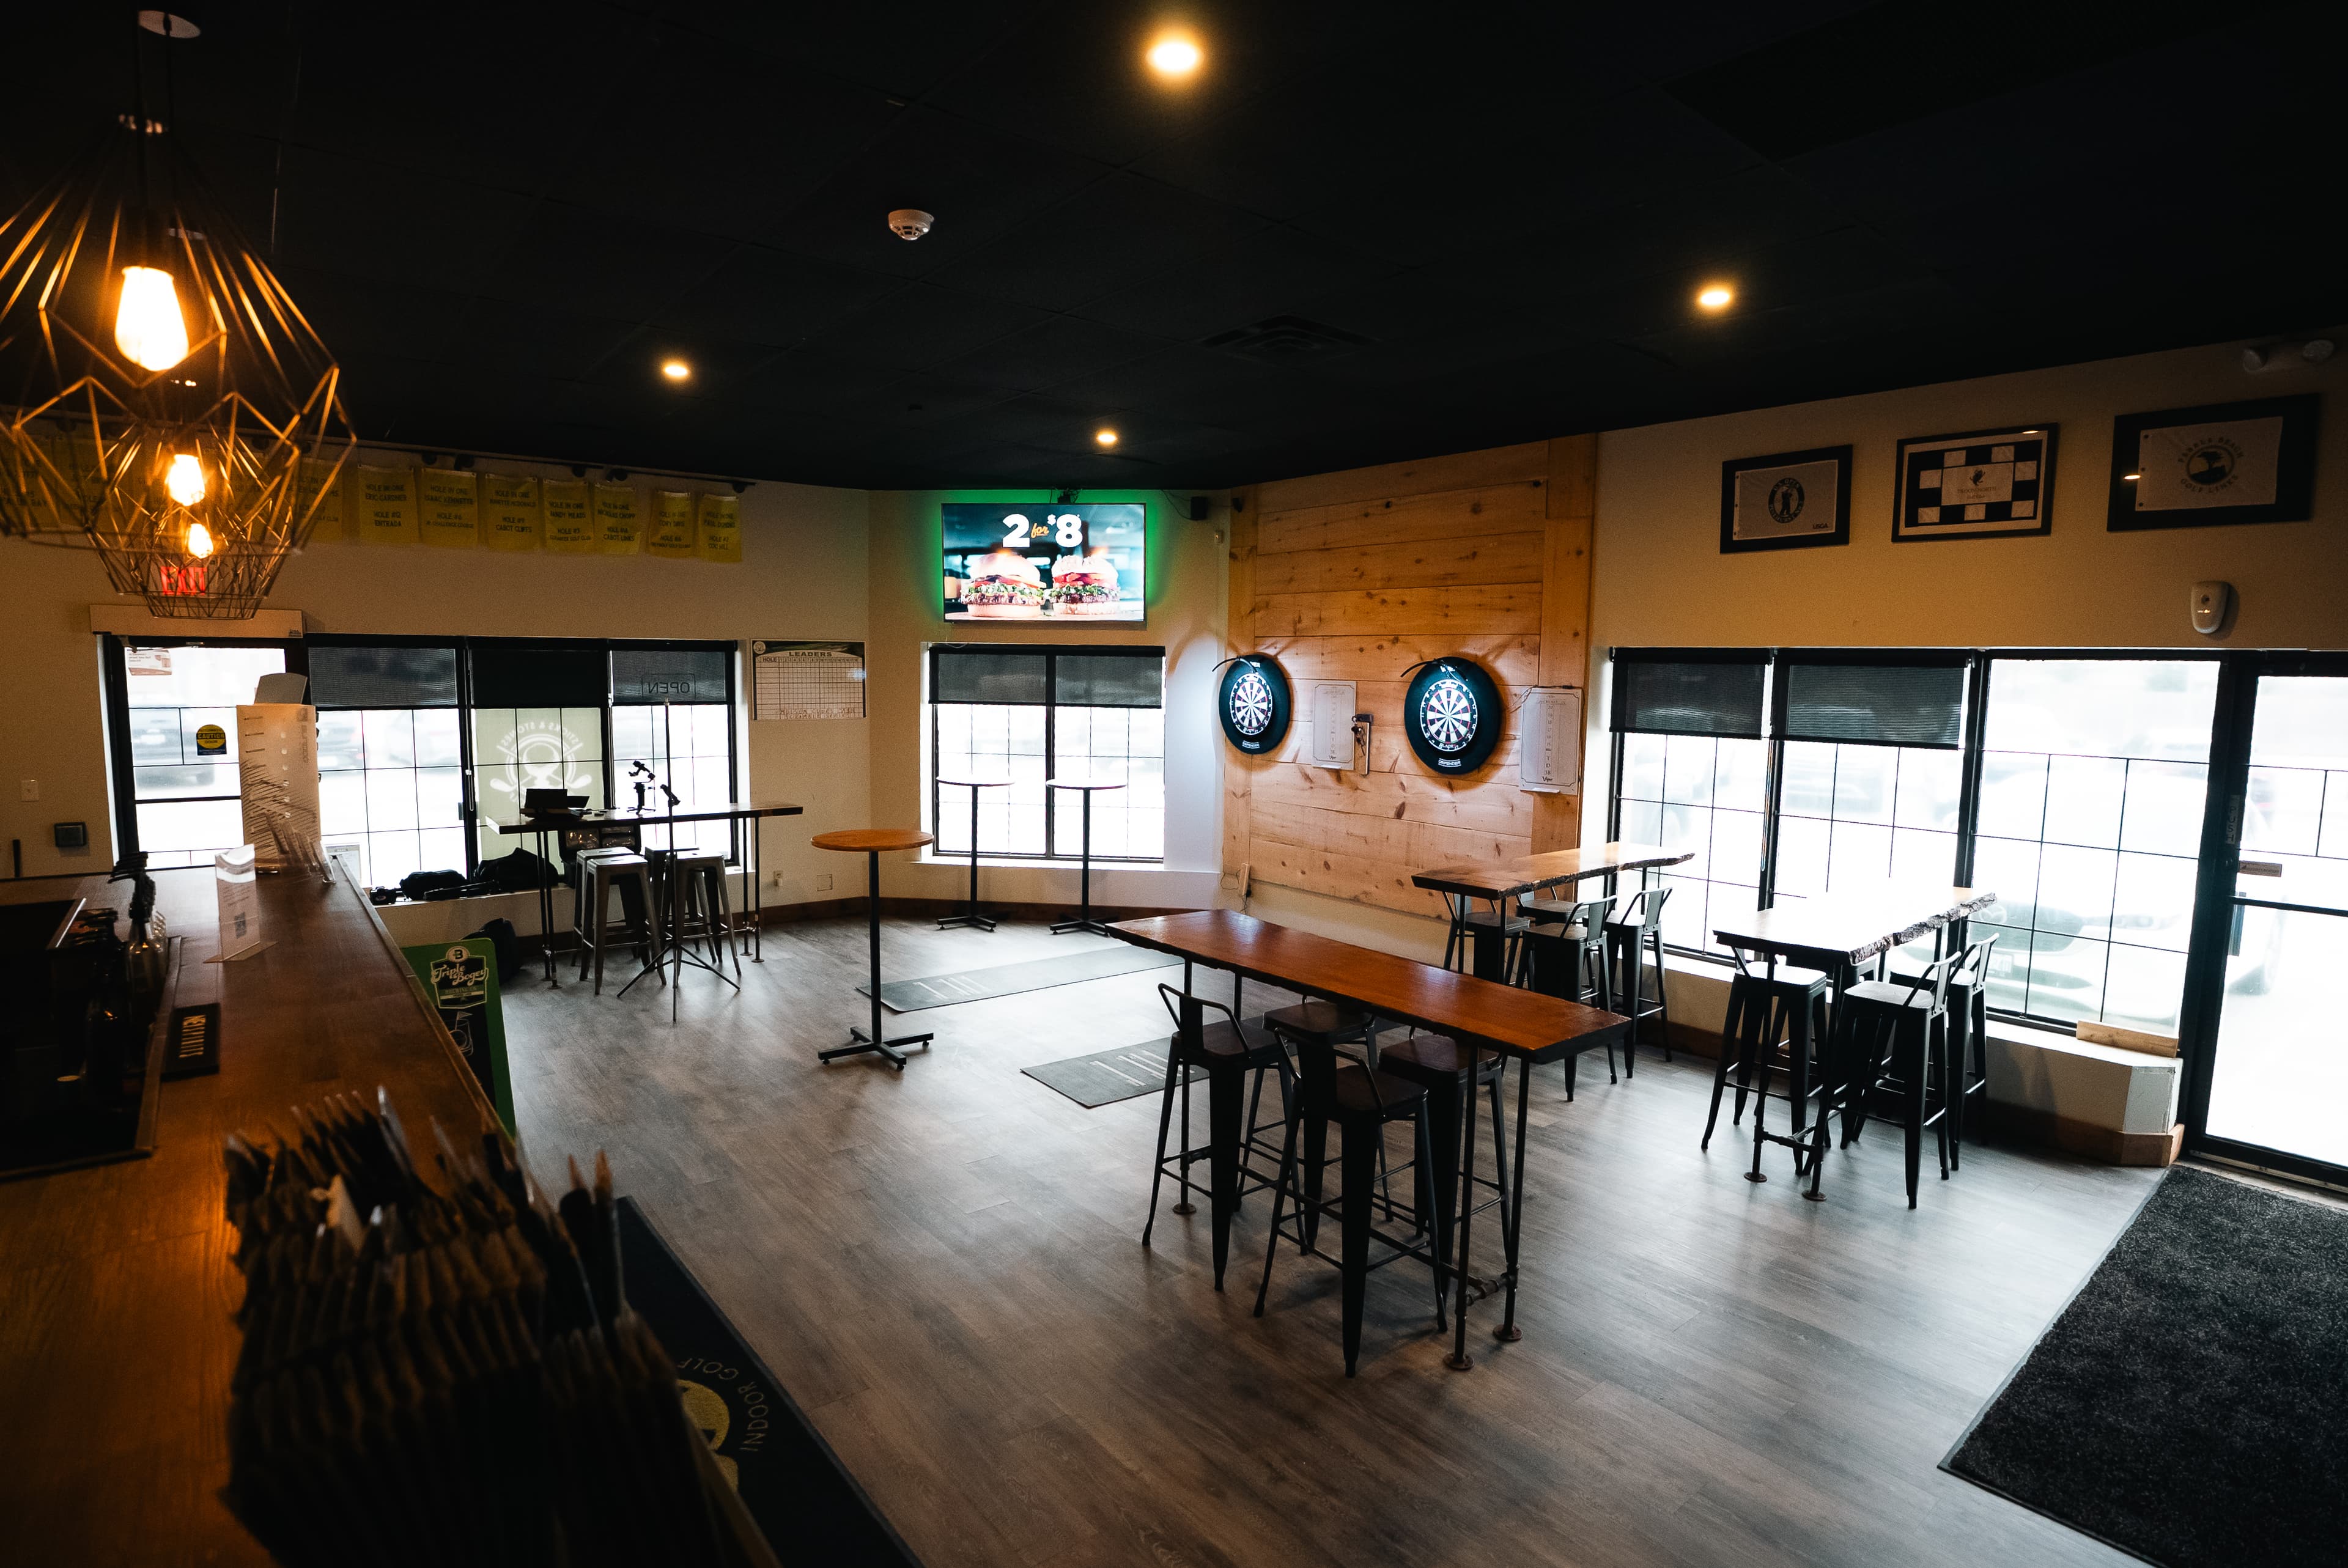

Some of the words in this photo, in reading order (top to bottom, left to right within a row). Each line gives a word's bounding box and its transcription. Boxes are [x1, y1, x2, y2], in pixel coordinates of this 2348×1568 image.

[2218, 436, 2245, 459] BEACH
[2180, 477, 2203, 493] GOLF
[2208, 474, 2239, 493] LINKS
[1002, 513, 1030, 548] 2
[1031, 523, 1049, 539] for
[160, 566, 208, 596] EXIT
[431, 963, 465, 985] Triple
[452, 969, 486, 986] Bogey
[677, 1358, 739, 1380] GOLF
[737, 1380, 769, 1452] INDOOR
